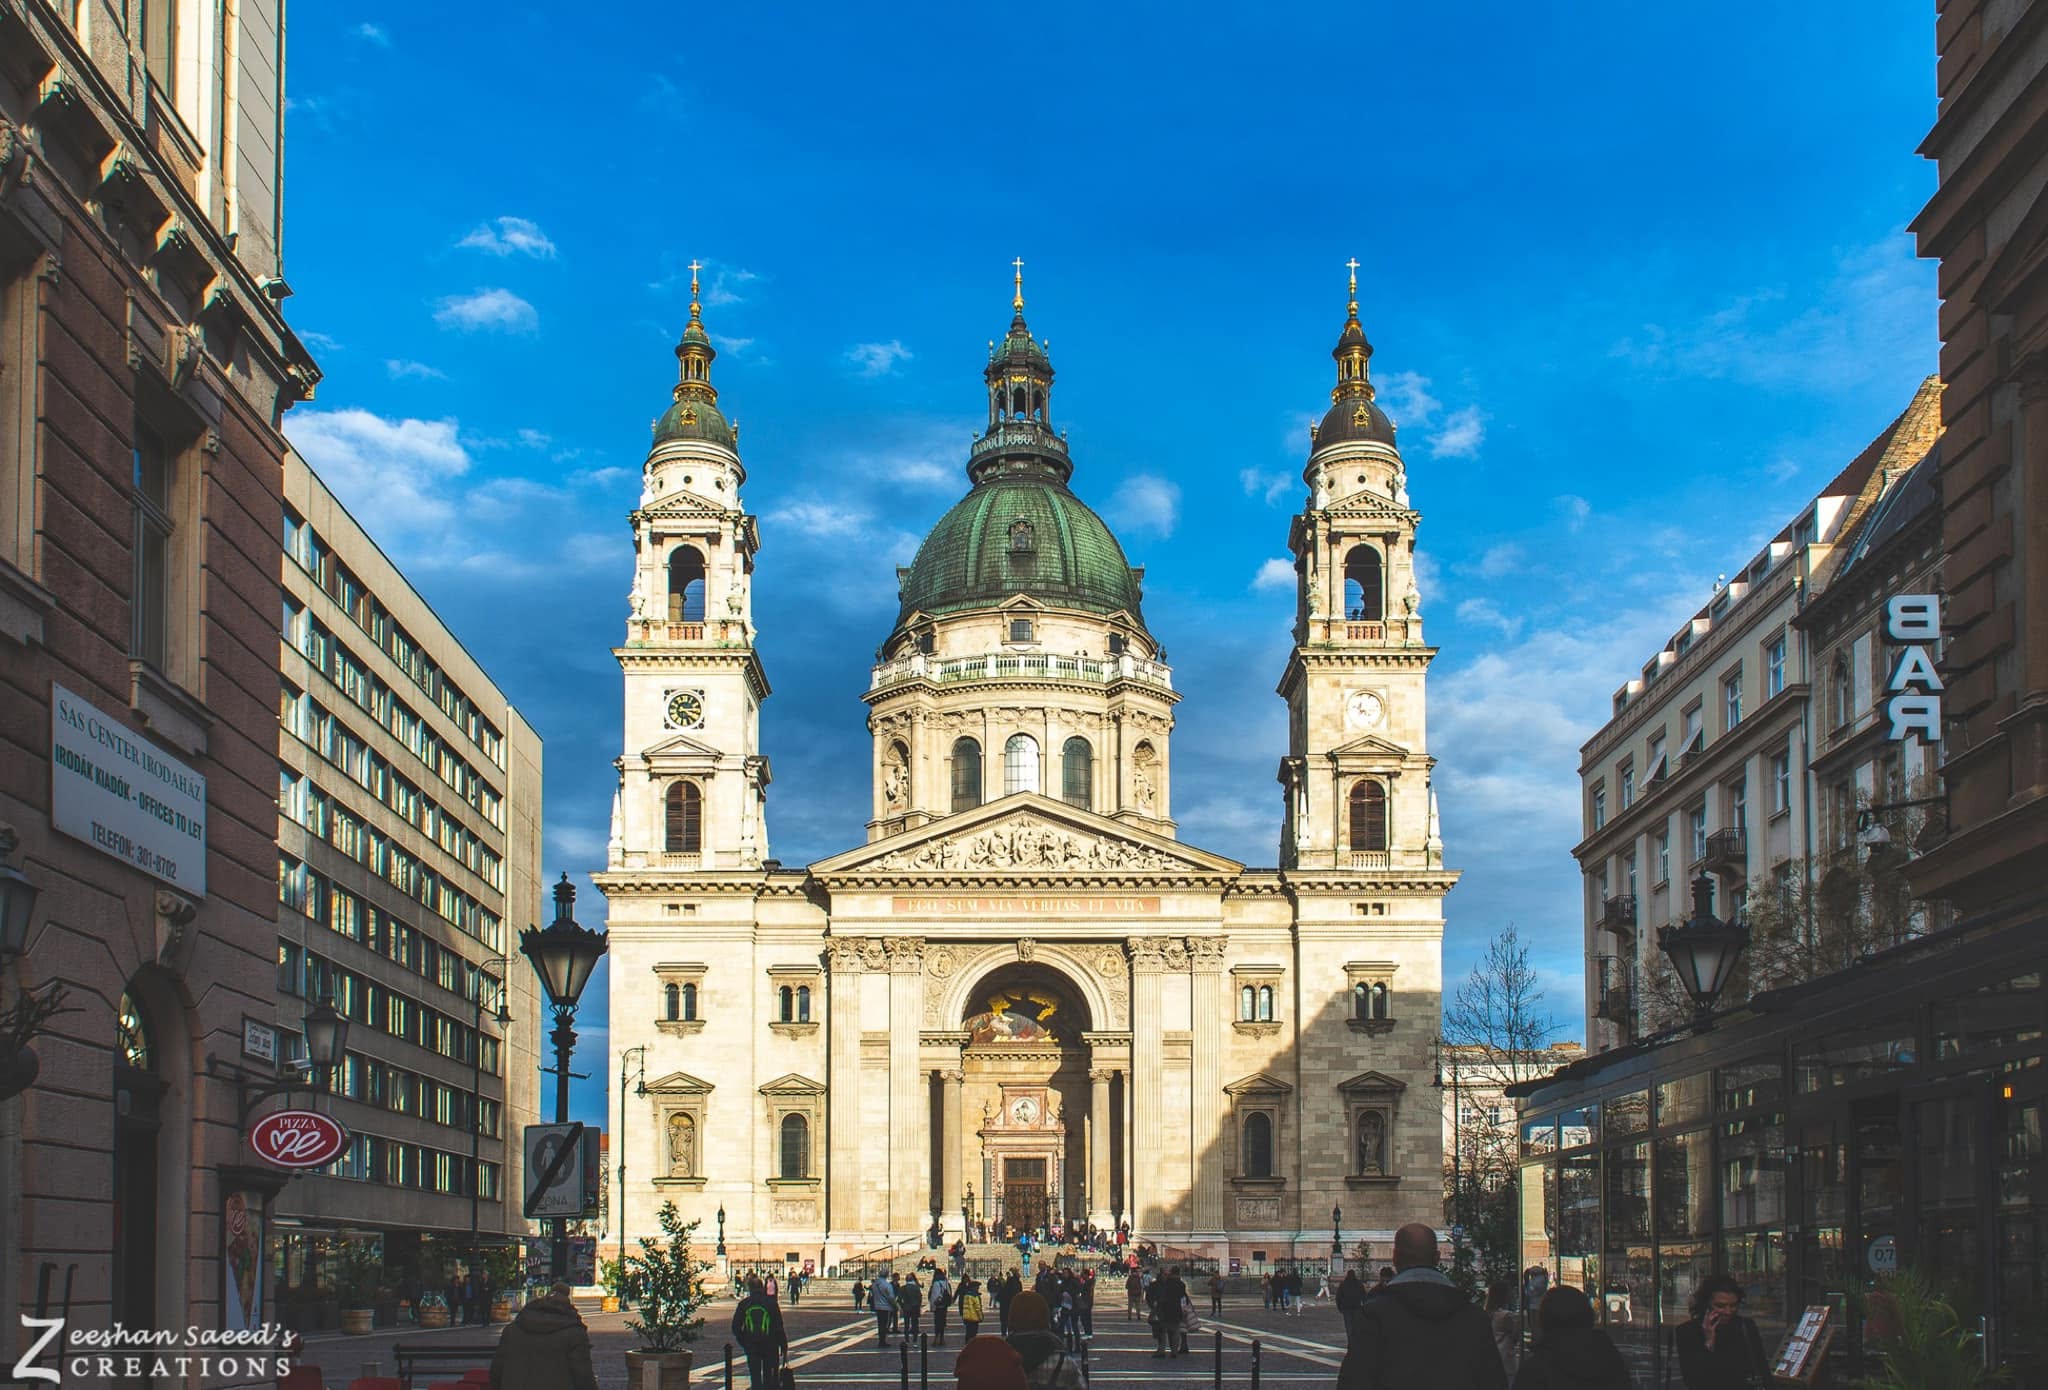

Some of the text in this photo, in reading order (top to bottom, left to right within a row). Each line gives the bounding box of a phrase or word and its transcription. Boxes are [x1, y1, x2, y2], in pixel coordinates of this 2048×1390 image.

[60, 699, 201, 801] SAS CENTER IRODAHÁZ
[55, 743, 94, 782] IRODÁK
[95, 766, 131, 802] KIADÓK
[139, 791, 174, 827] OFFICES
[176, 812, 187, 833] TO
[188, 819, 203, 841] LET
[91, 821, 177, 880] TELEFON: 301-8702
[279, 1118, 318, 1129] PIZZA
